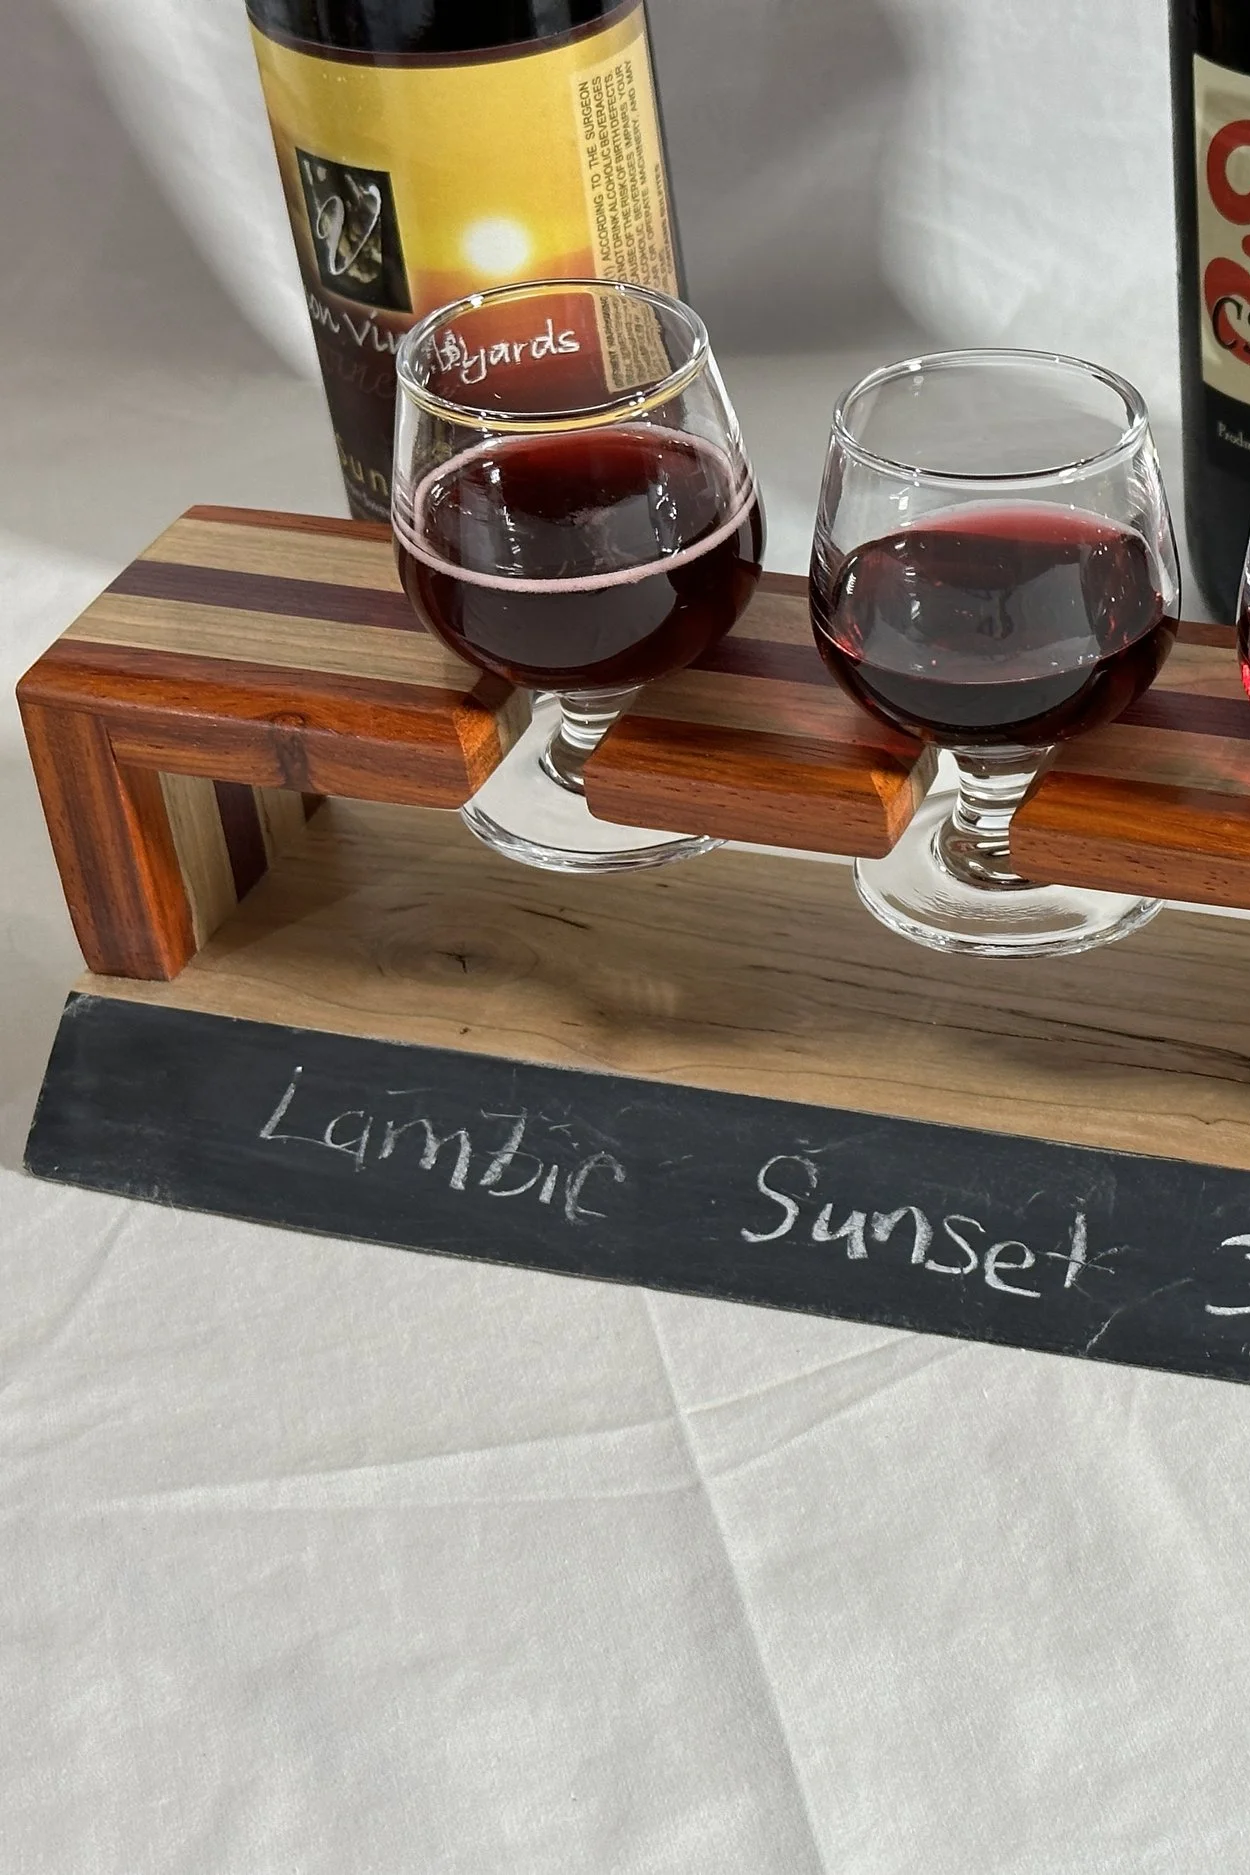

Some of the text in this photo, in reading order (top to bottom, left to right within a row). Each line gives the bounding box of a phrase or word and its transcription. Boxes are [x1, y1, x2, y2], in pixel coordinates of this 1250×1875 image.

[614, 64, 626, 101] YOUR
[624, 60, 634, 84] MAY
[578, 81, 595, 140] SURGEON
[591, 75, 609, 148] BEVERAGES
[628, 87, 637, 112] AND
[620, 102, 633, 150] IMPAIRS
[586, 144, 599, 170] THE
[611, 130, 624, 164] BIRTH
[590, 173, 602, 190] TO
[600, 147, 618, 212] ALCOHOLIC
[615, 165, 627, 182] OF
[626, 151, 643, 221] BEVERAGES
[619, 183, 630, 207] RISK
[594, 193, 612, 261] ACCORDING
[609, 214, 623, 251] DRINK
[621, 207, 633, 231] THE
[641, 187, 655, 241] OPERATE
[625, 233, 636, 247] OF
[614, 251, 626, 273] NOT
[626, 247, 641, 285] CAUSE
[259, 1066, 626, 1225] Lambic
[741, 1153, 1124, 1298] Sunset
